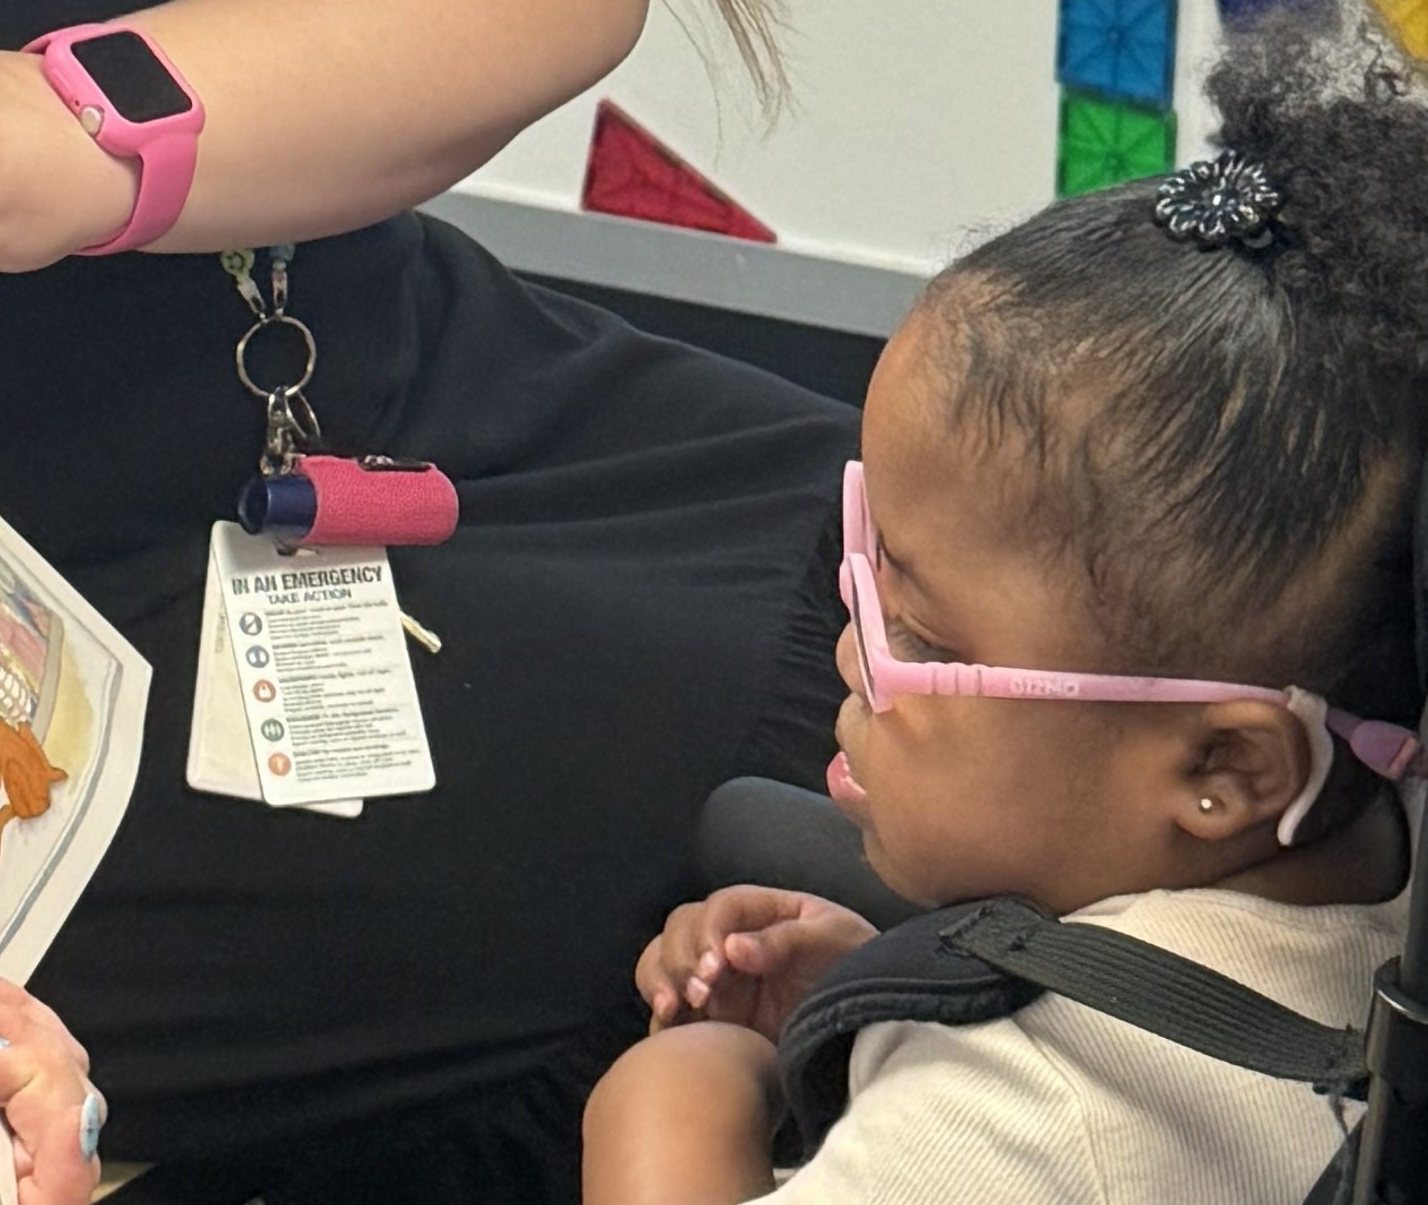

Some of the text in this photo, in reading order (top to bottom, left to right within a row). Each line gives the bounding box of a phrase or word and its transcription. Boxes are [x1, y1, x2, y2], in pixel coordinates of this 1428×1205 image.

[232, 565, 384, 595] IN AN EMERGENCY
[267, 588, 353, 606] TAKE ACTION
